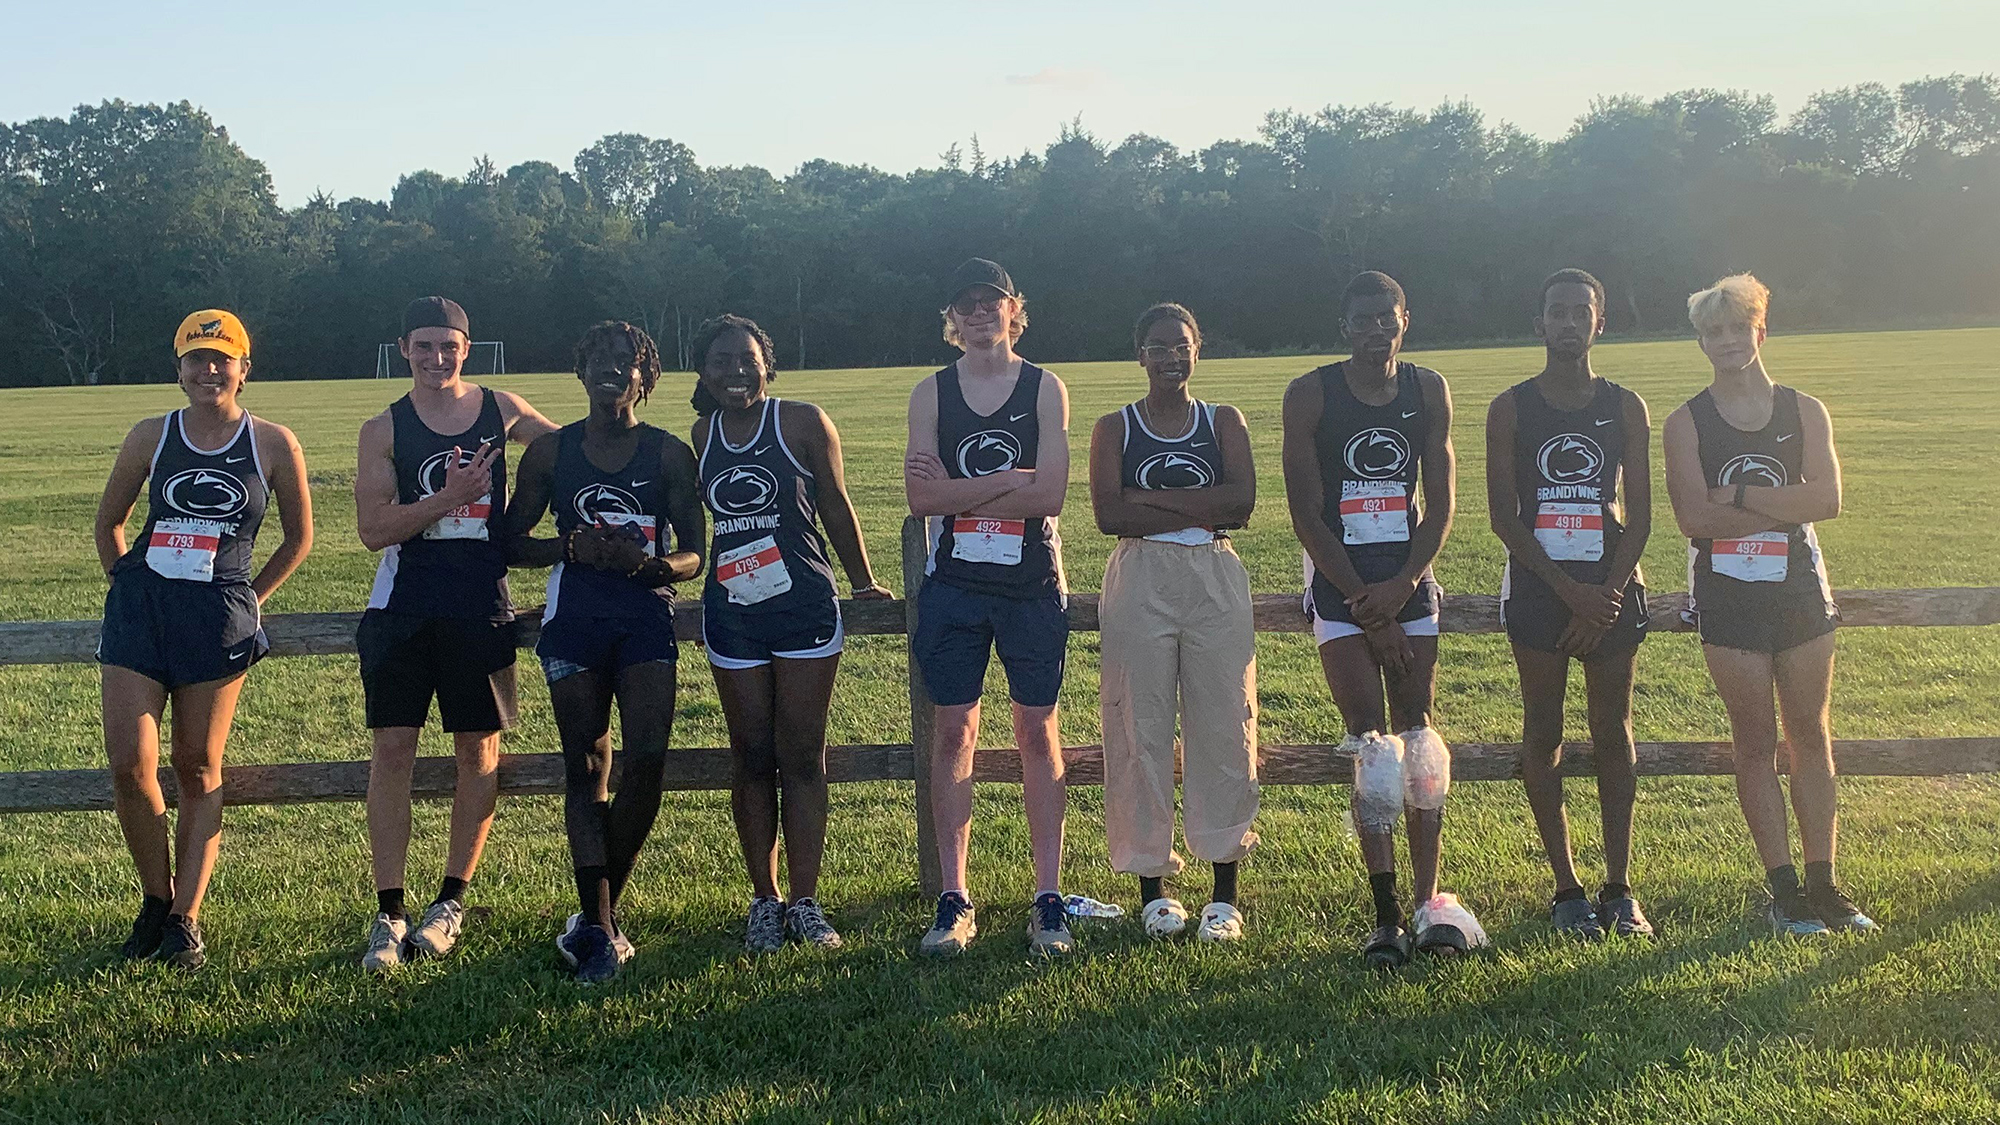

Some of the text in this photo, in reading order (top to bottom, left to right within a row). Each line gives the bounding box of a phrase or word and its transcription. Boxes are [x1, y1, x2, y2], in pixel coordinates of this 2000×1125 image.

[1537, 485, 1602, 501] BRANDYWNE
[1362, 499, 1386, 512] 4921
[714, 513, 781, 537] BRANDYWINE
[975, 520, 1001, 533] 4922
[1555, 516, 1582, 529] 4918
[167, 535, 195, 548] 4793
[1736, 542, 1763, 555] 4927
[735, 556, 760, 574] 4795
